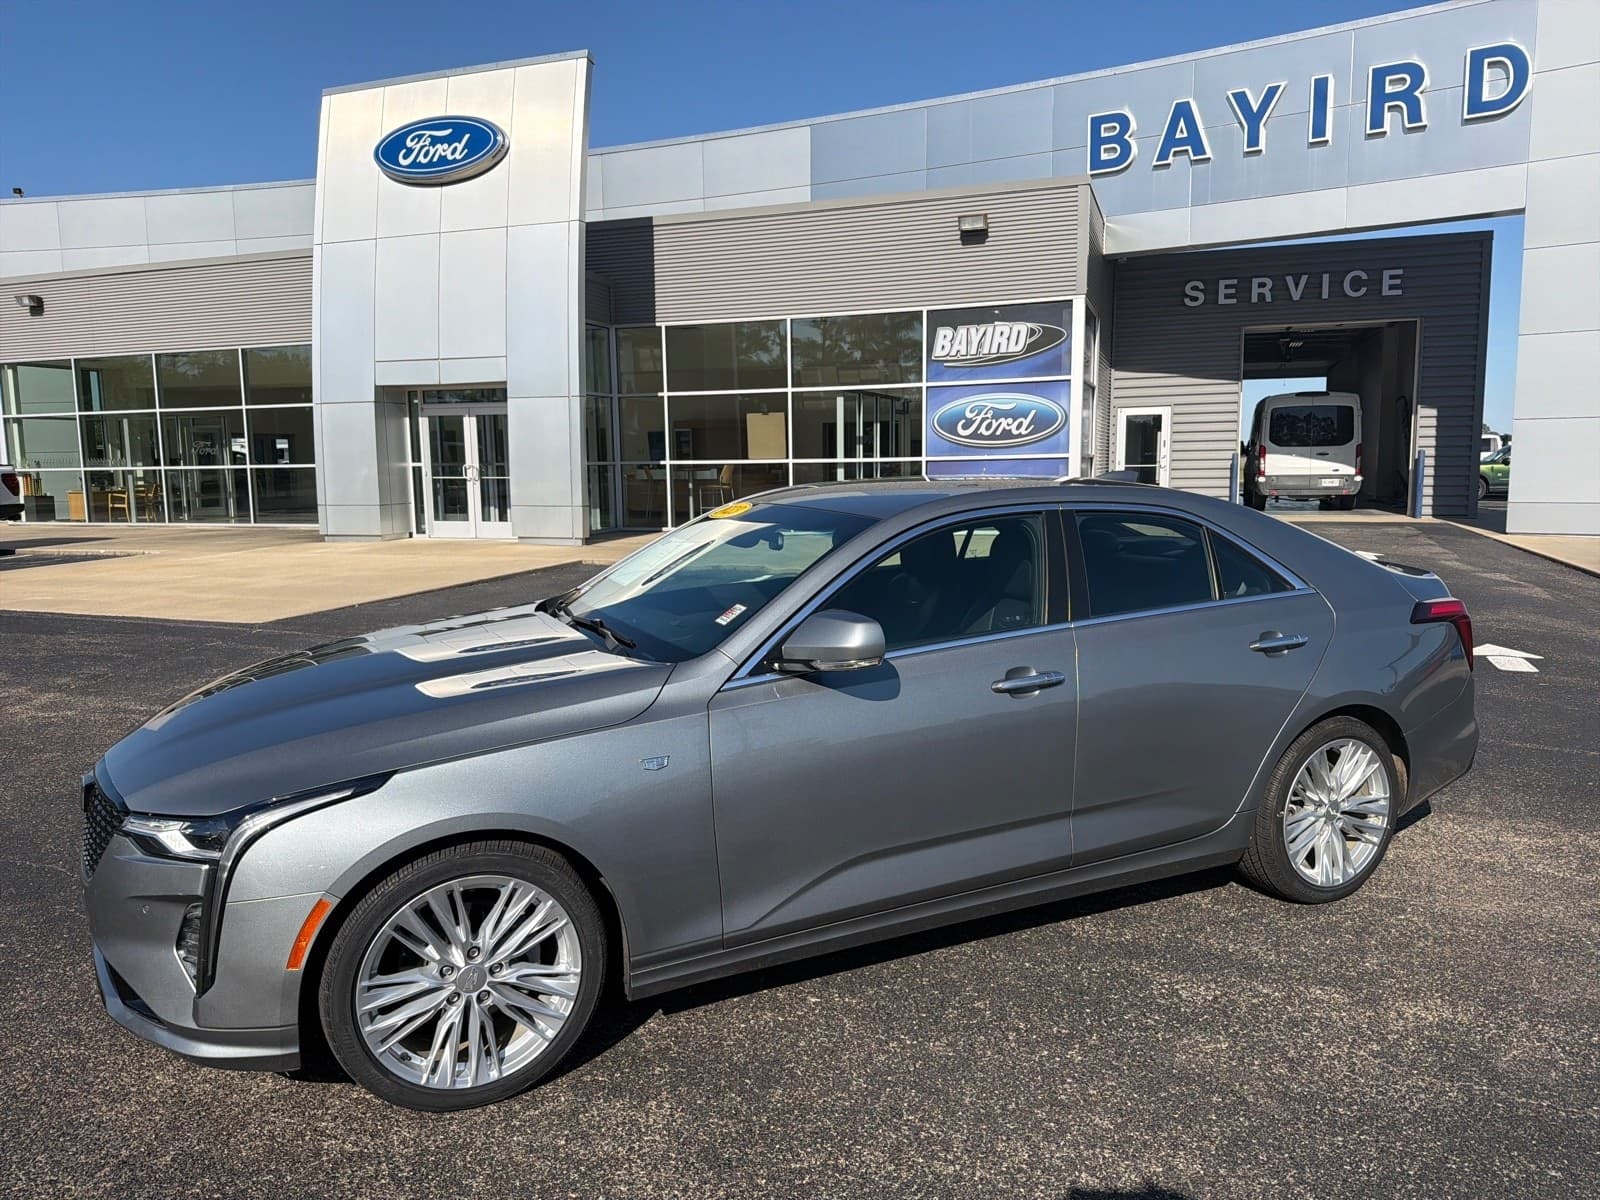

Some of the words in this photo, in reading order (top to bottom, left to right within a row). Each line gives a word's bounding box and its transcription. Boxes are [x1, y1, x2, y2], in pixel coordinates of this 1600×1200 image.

[1087, 42, 1532, 175] BAYIRD
[398, 128, 471, 166] Ford
[1183, 268, 1406, 307] SERVICE
[933, 323, 1029, 358] BAYIRD
[957, 402, 1036, 436] Ford
